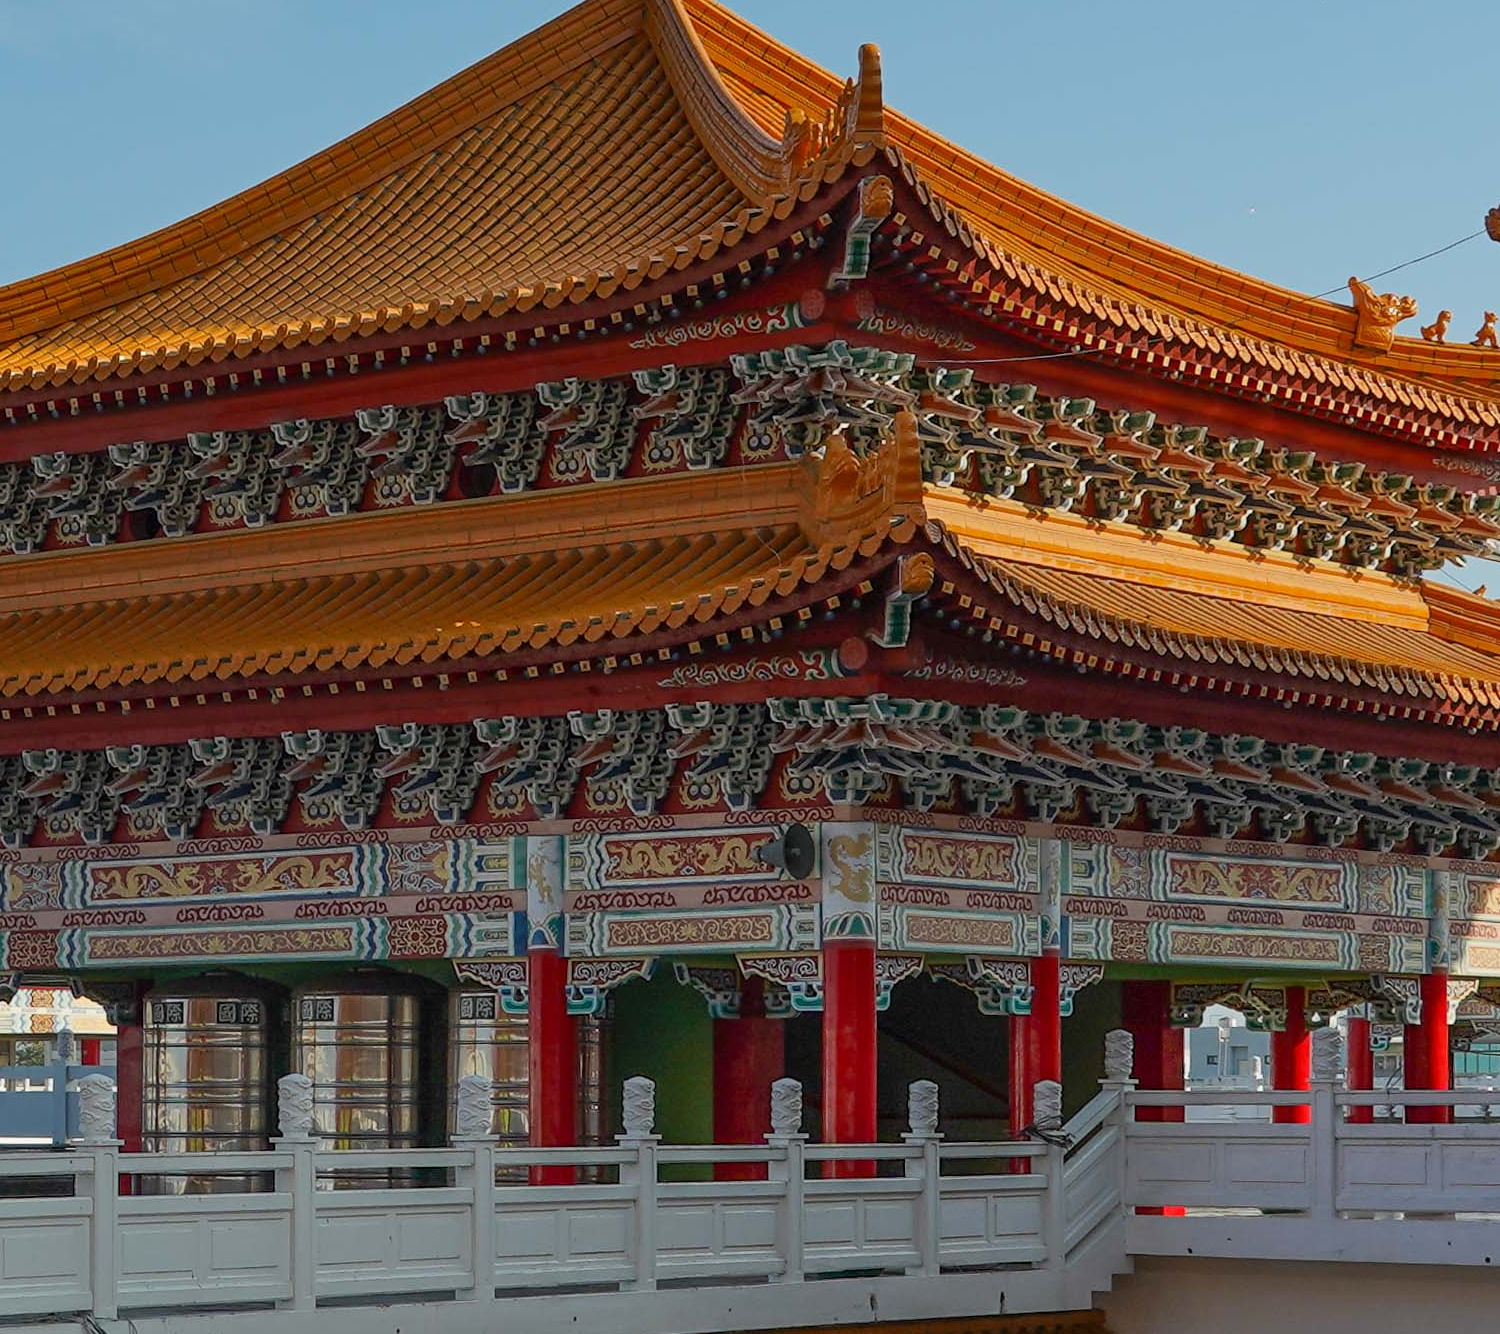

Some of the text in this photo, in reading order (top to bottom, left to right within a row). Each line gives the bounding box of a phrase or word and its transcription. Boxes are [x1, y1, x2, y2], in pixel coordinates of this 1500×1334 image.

[153, 1002, 183, 1024] 國際
[218, 1002, 260, 1024] 國際
[301, 999, 333, 1022] 國際
[460, 995, 496, 1020] 國際
